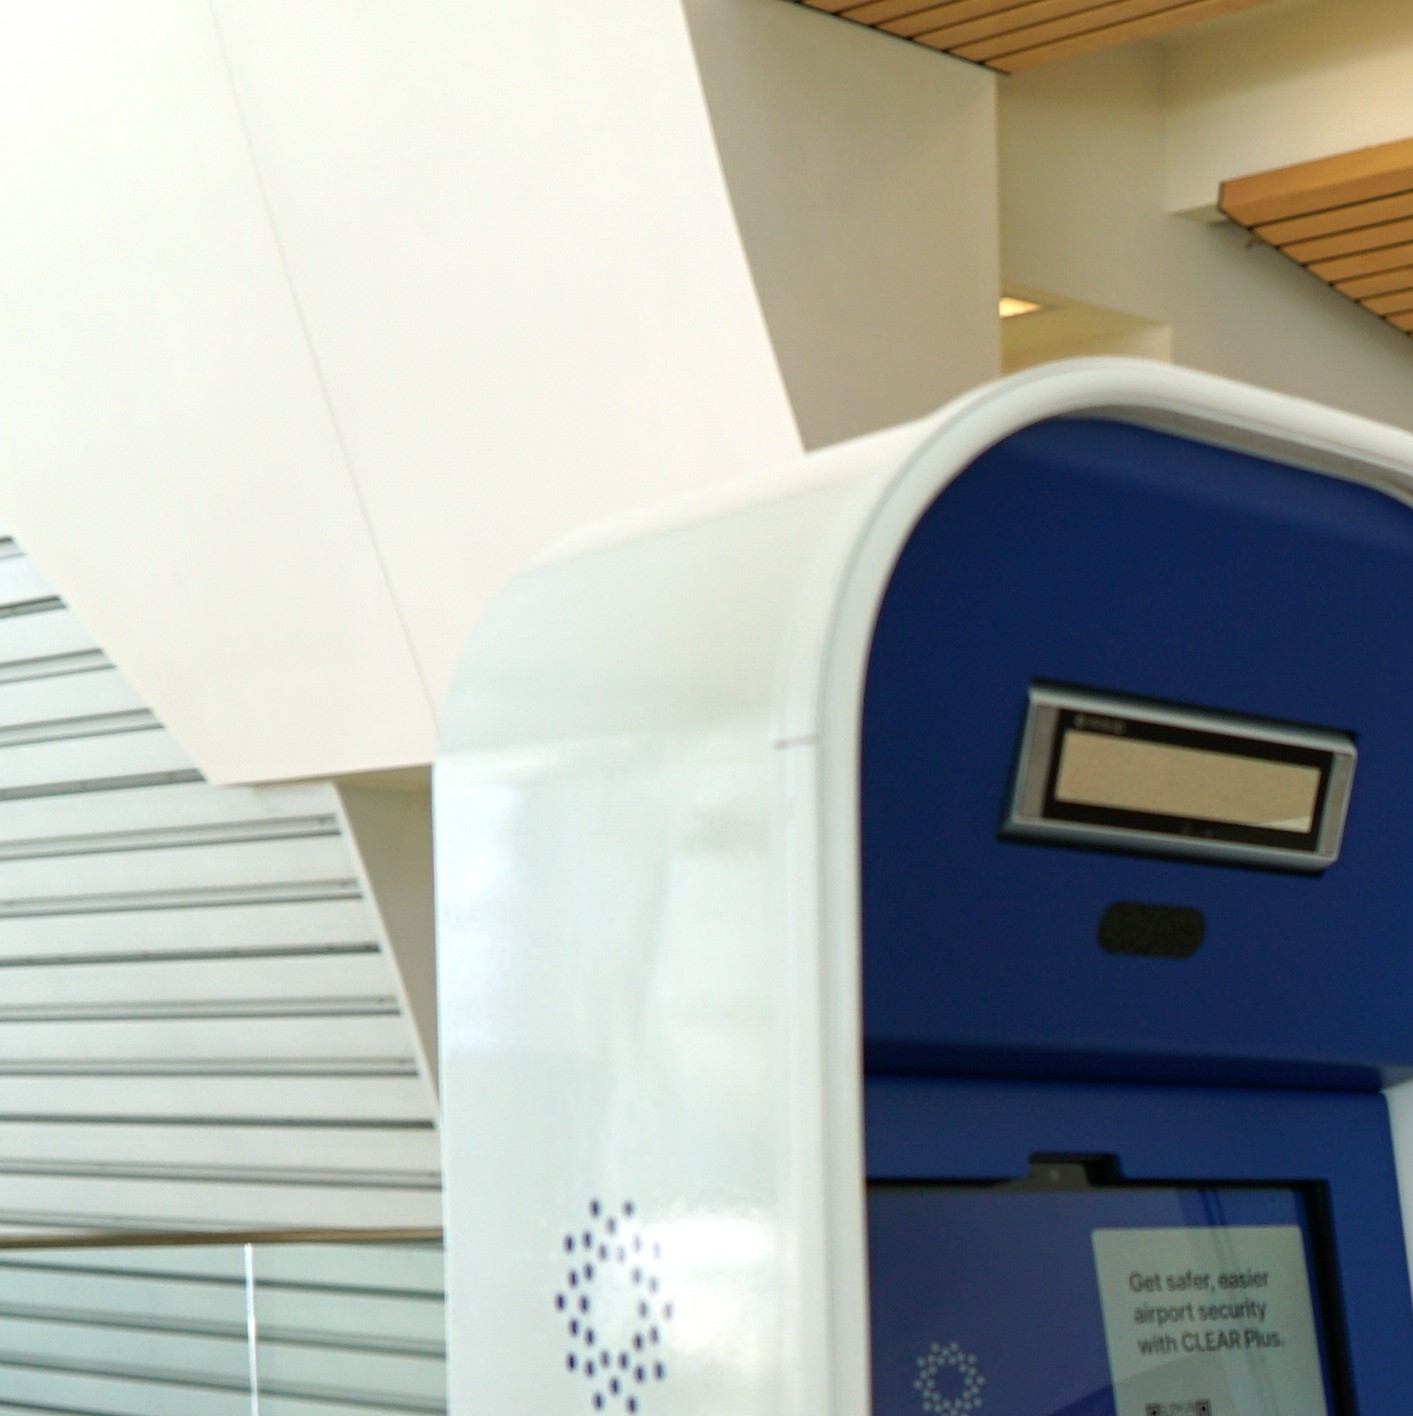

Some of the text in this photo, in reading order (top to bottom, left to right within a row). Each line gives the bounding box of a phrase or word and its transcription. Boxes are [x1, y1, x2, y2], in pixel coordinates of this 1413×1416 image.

[1128, 1269, 1269, 1295] Get safer, easier
[1133, 1297, 1267, 1327] airport security
[1137, 1327, 1286, 1356] with CLEAR Plus.
